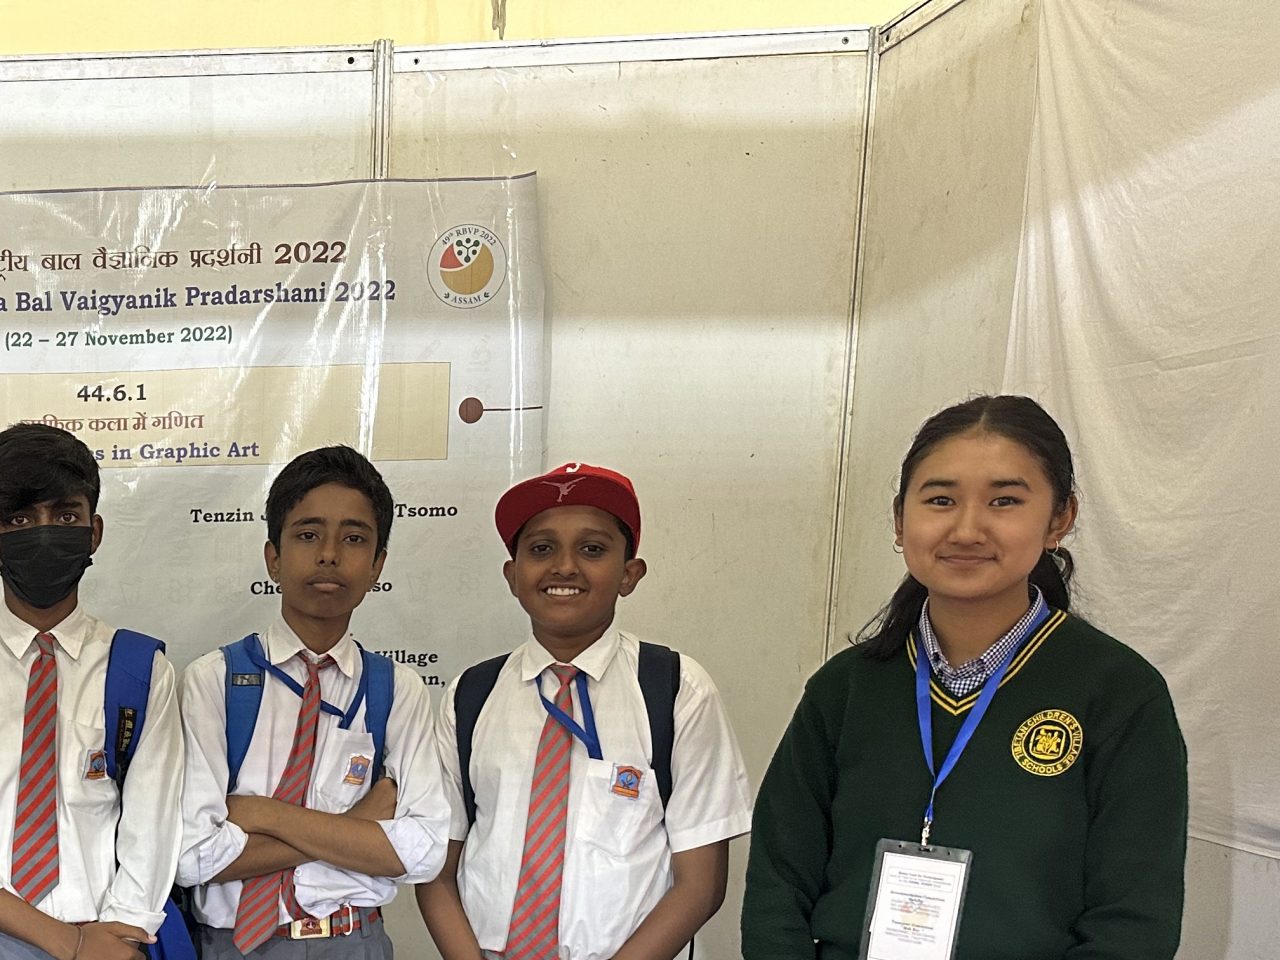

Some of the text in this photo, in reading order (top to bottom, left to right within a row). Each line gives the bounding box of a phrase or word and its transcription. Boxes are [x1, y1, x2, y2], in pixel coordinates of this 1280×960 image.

[455, 227, 479, 237] RBVP
[480, 231, 496, 246] 2022
[41, 253, 82, 271] बाल
[92, 246, 179, 270] वैज्ञानिक
[190, 242, 263, 268] प्रदर्शनी
[274, 241, 347, 265] 2022
[15, 291, 53, 312] Bal
[60, 287, 177, 316] Vaigyanik
[185, 282, 326, 308] Pradarshani
[334, 280, 396, 302] 2022
[451, 295, 481, 304] ASSAM
[4, 332, 33, 351] (22
[56, 331, 79, 347] 27
[84, 328, 174, 347] November
[180, 325, 233, 345] 2022)
[77, 384, 147, 402] 44.6.1
[88, 416, 128, 432] कला
[132, 412, 148, 431] में
[152, 410, 205, 430] गणित
[111, 444, 132, 460] in
[139, 443, 220, 463] Graphic
[227, 441, 260, 459] Art
[190, 508, 254, 523] Tenzin
[395, 504, 458, 518] Tsomo
[1022, 758, 1063, 774] SCHOOLS
